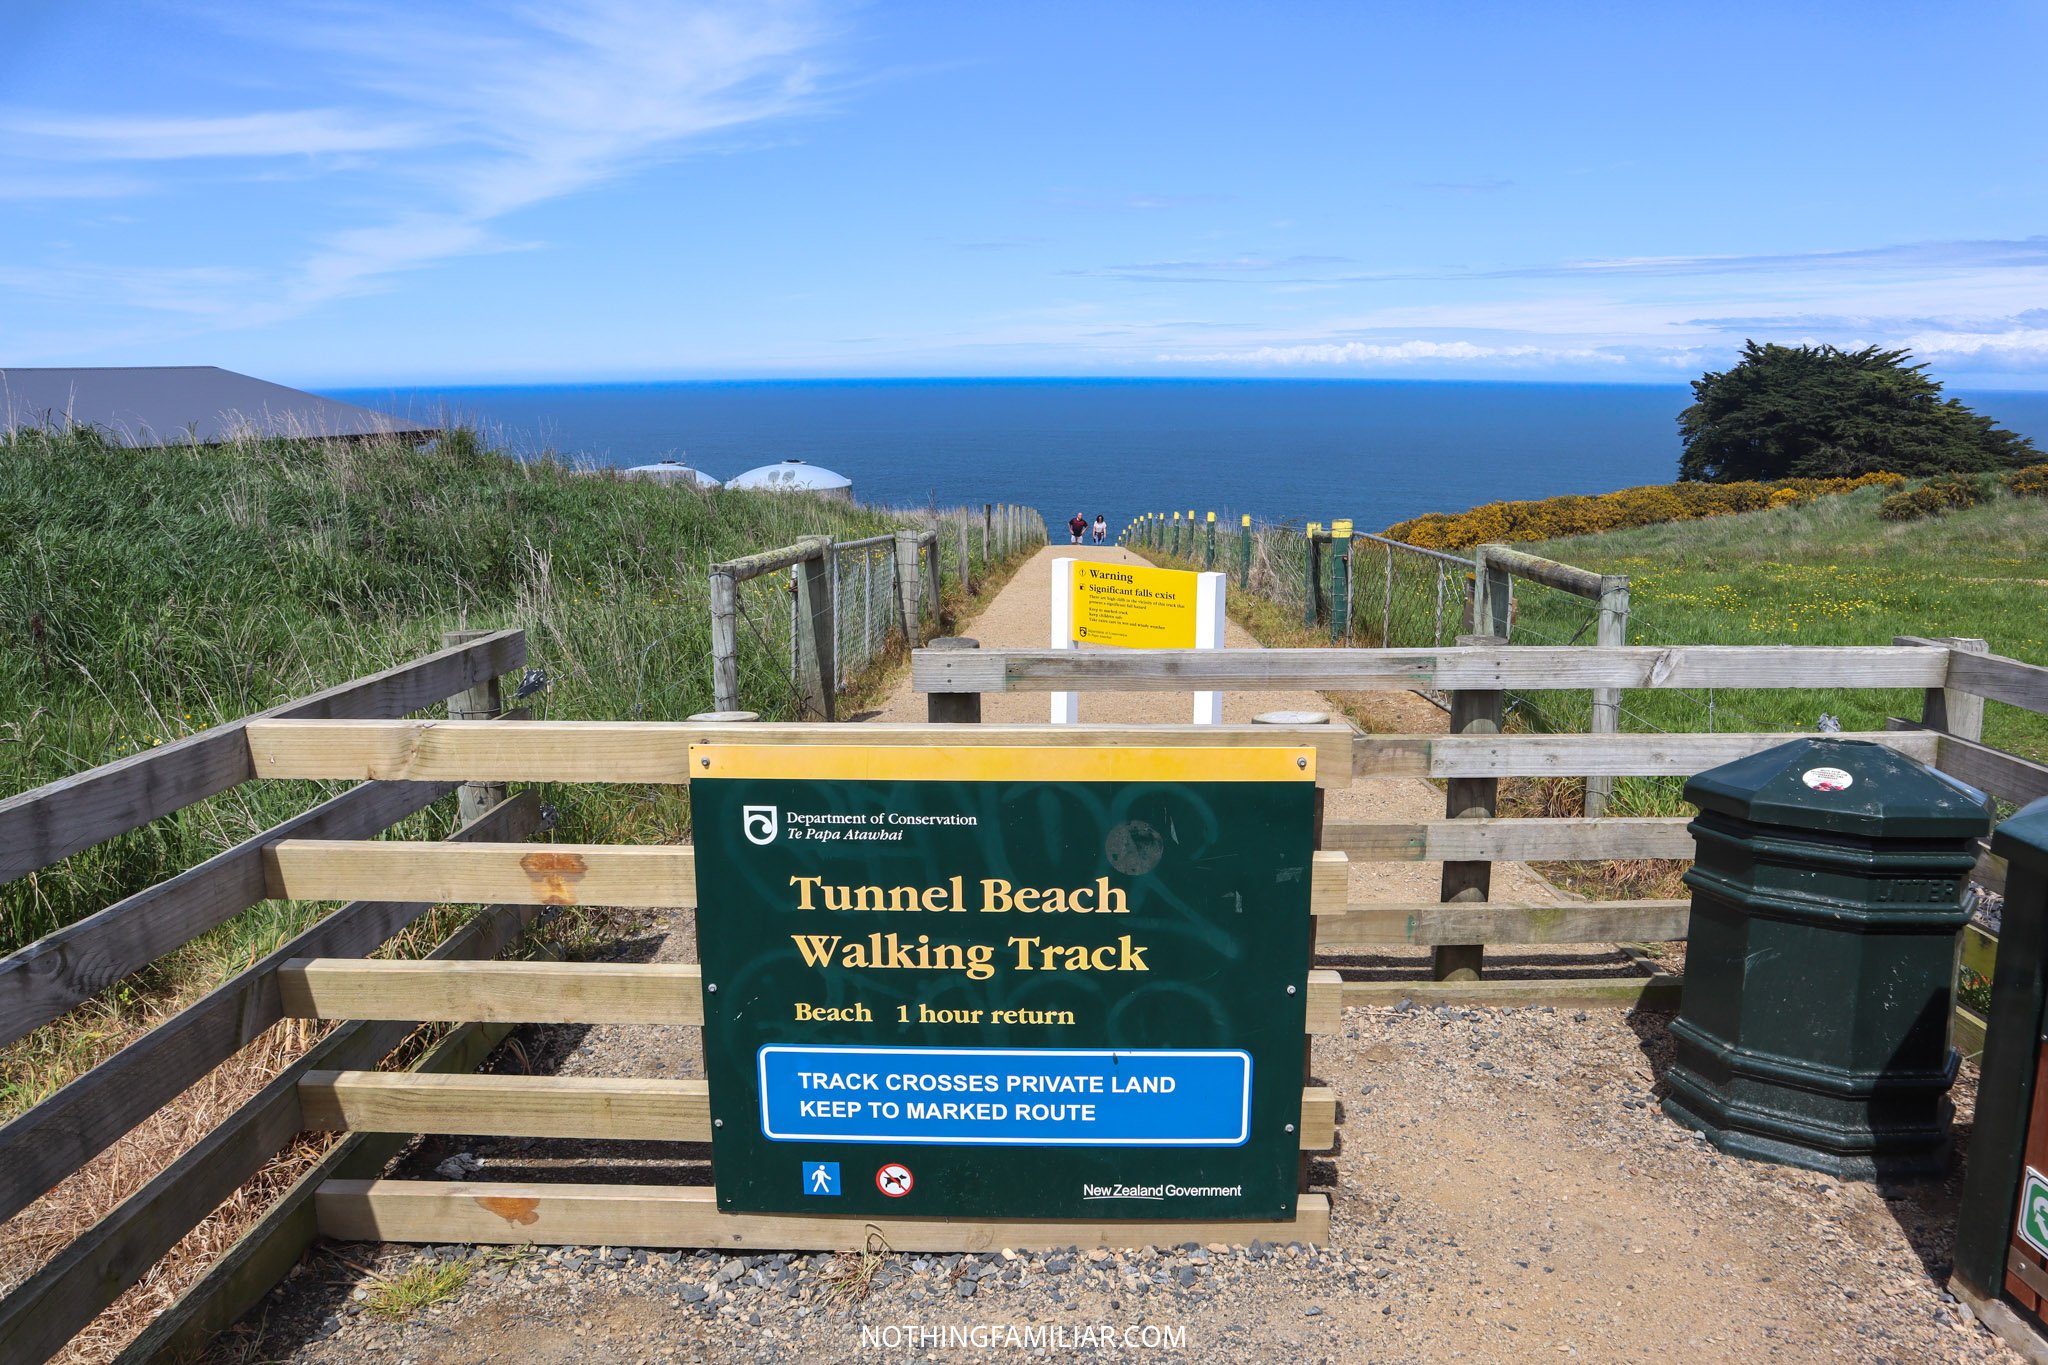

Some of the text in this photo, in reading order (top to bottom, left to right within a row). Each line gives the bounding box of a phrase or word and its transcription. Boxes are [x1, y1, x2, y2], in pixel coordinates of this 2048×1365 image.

[1090, 569, 1133, 584] Warning
[1089, 584, 1176, 600] Significant falls exist
[787, 812, 977, 826] Department of Conservation
[788, 828, 903, 842] Te Papa Atawhai
[790, 876, 1130, 913] Tunnel Beach
[791, 933, 1149, 979] Walking Track
[795, 1003, 1075, 1024] Beach 1 hour return
[798, 1073, 1175, 1093] TRACK CROSSES PRIVATE LAND
[801, 1101, 1095, 1120] KEEP TO MARKED ROUTE
[1084, 1184, 1241, 1196] New Zealand Government
